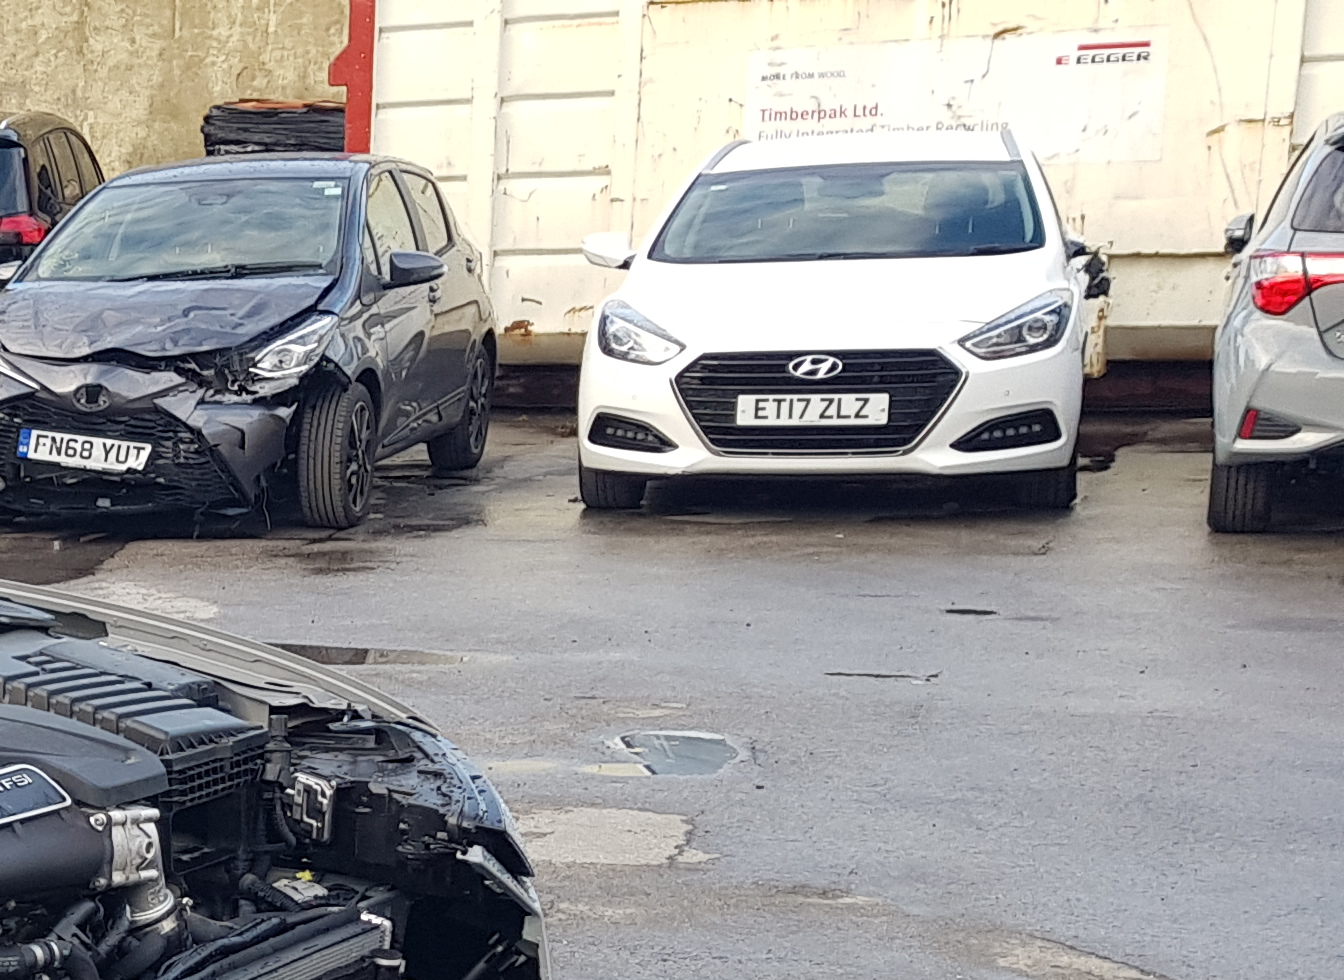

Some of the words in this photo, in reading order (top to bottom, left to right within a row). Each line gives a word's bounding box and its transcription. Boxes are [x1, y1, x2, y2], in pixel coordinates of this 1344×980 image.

[1076, 50, 1151, 64] EGGER
[759, 103, 848, 123] Timberpak
[853, 101, 884, 118] Ltd.
[754, 398, 811, 420] ET17
[818, 397, 870, 419] ZLZ
[33, 434, 94, 460] FN68
[102, 441, 146, 464] YUT
